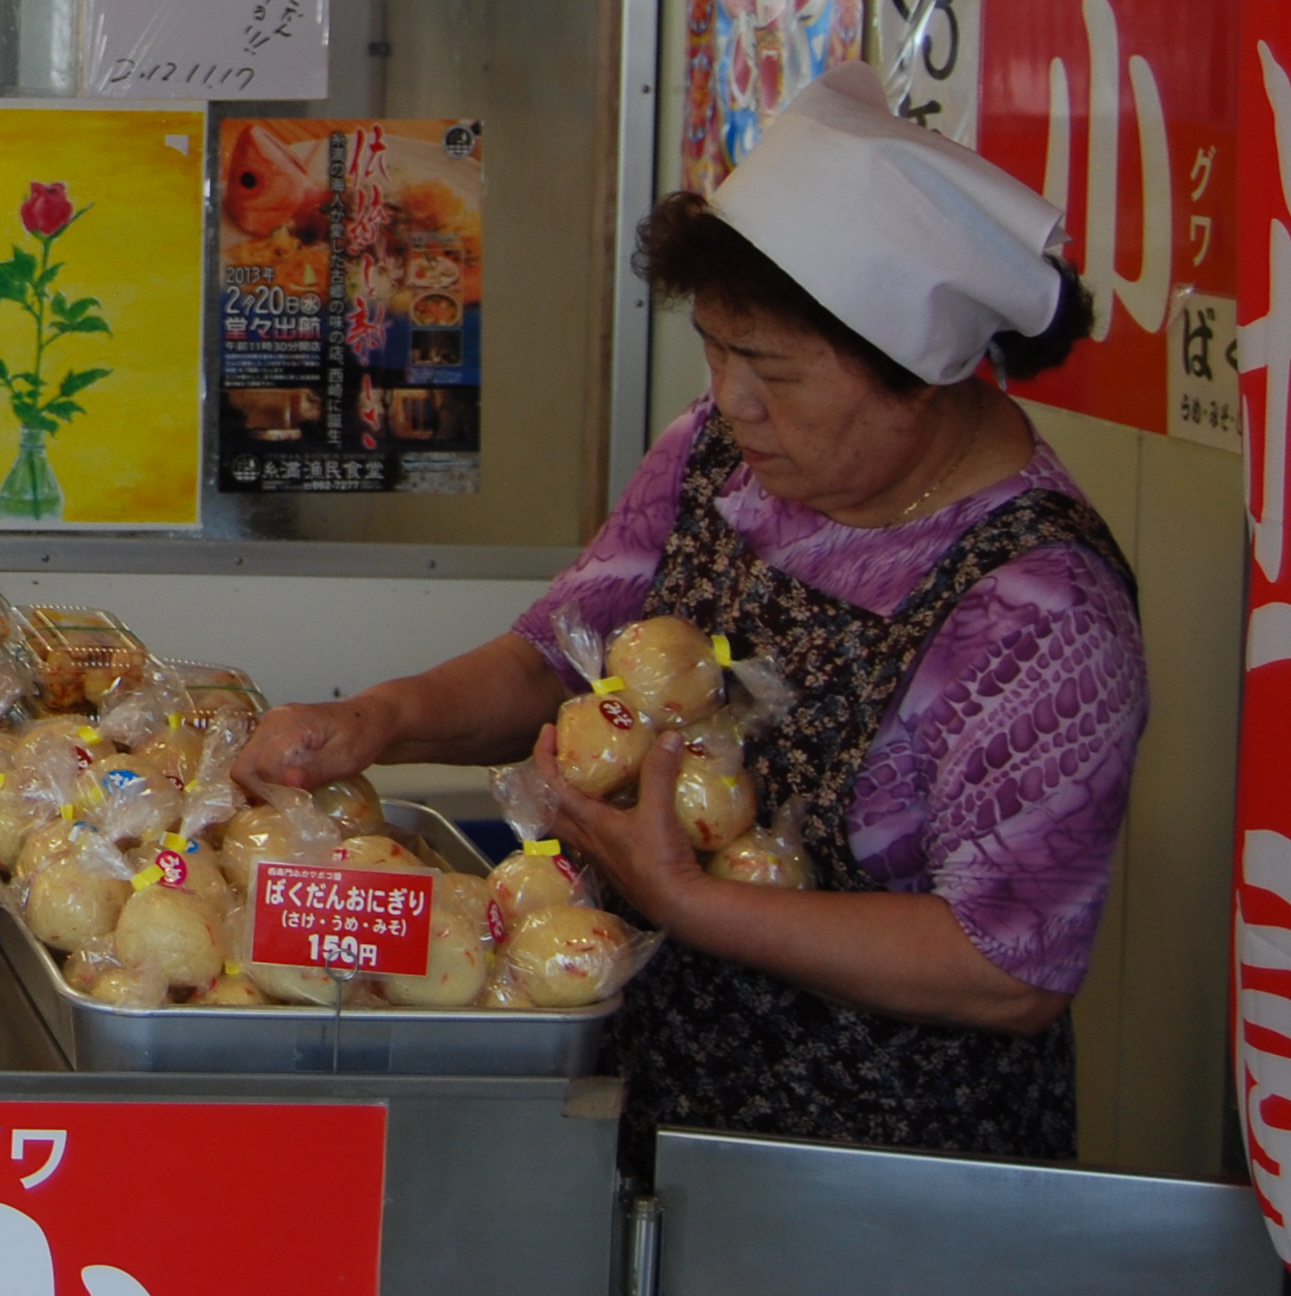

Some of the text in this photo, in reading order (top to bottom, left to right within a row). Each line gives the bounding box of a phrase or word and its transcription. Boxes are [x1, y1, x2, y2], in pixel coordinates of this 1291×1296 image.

[226, 267, 276, 284] 2013年
[265, 879, 425, 916] ばくだんおにぎり
[281, 910, 407, 937] (さけ・うめ・みそ)
[308, 934, 378, 967] 150円
